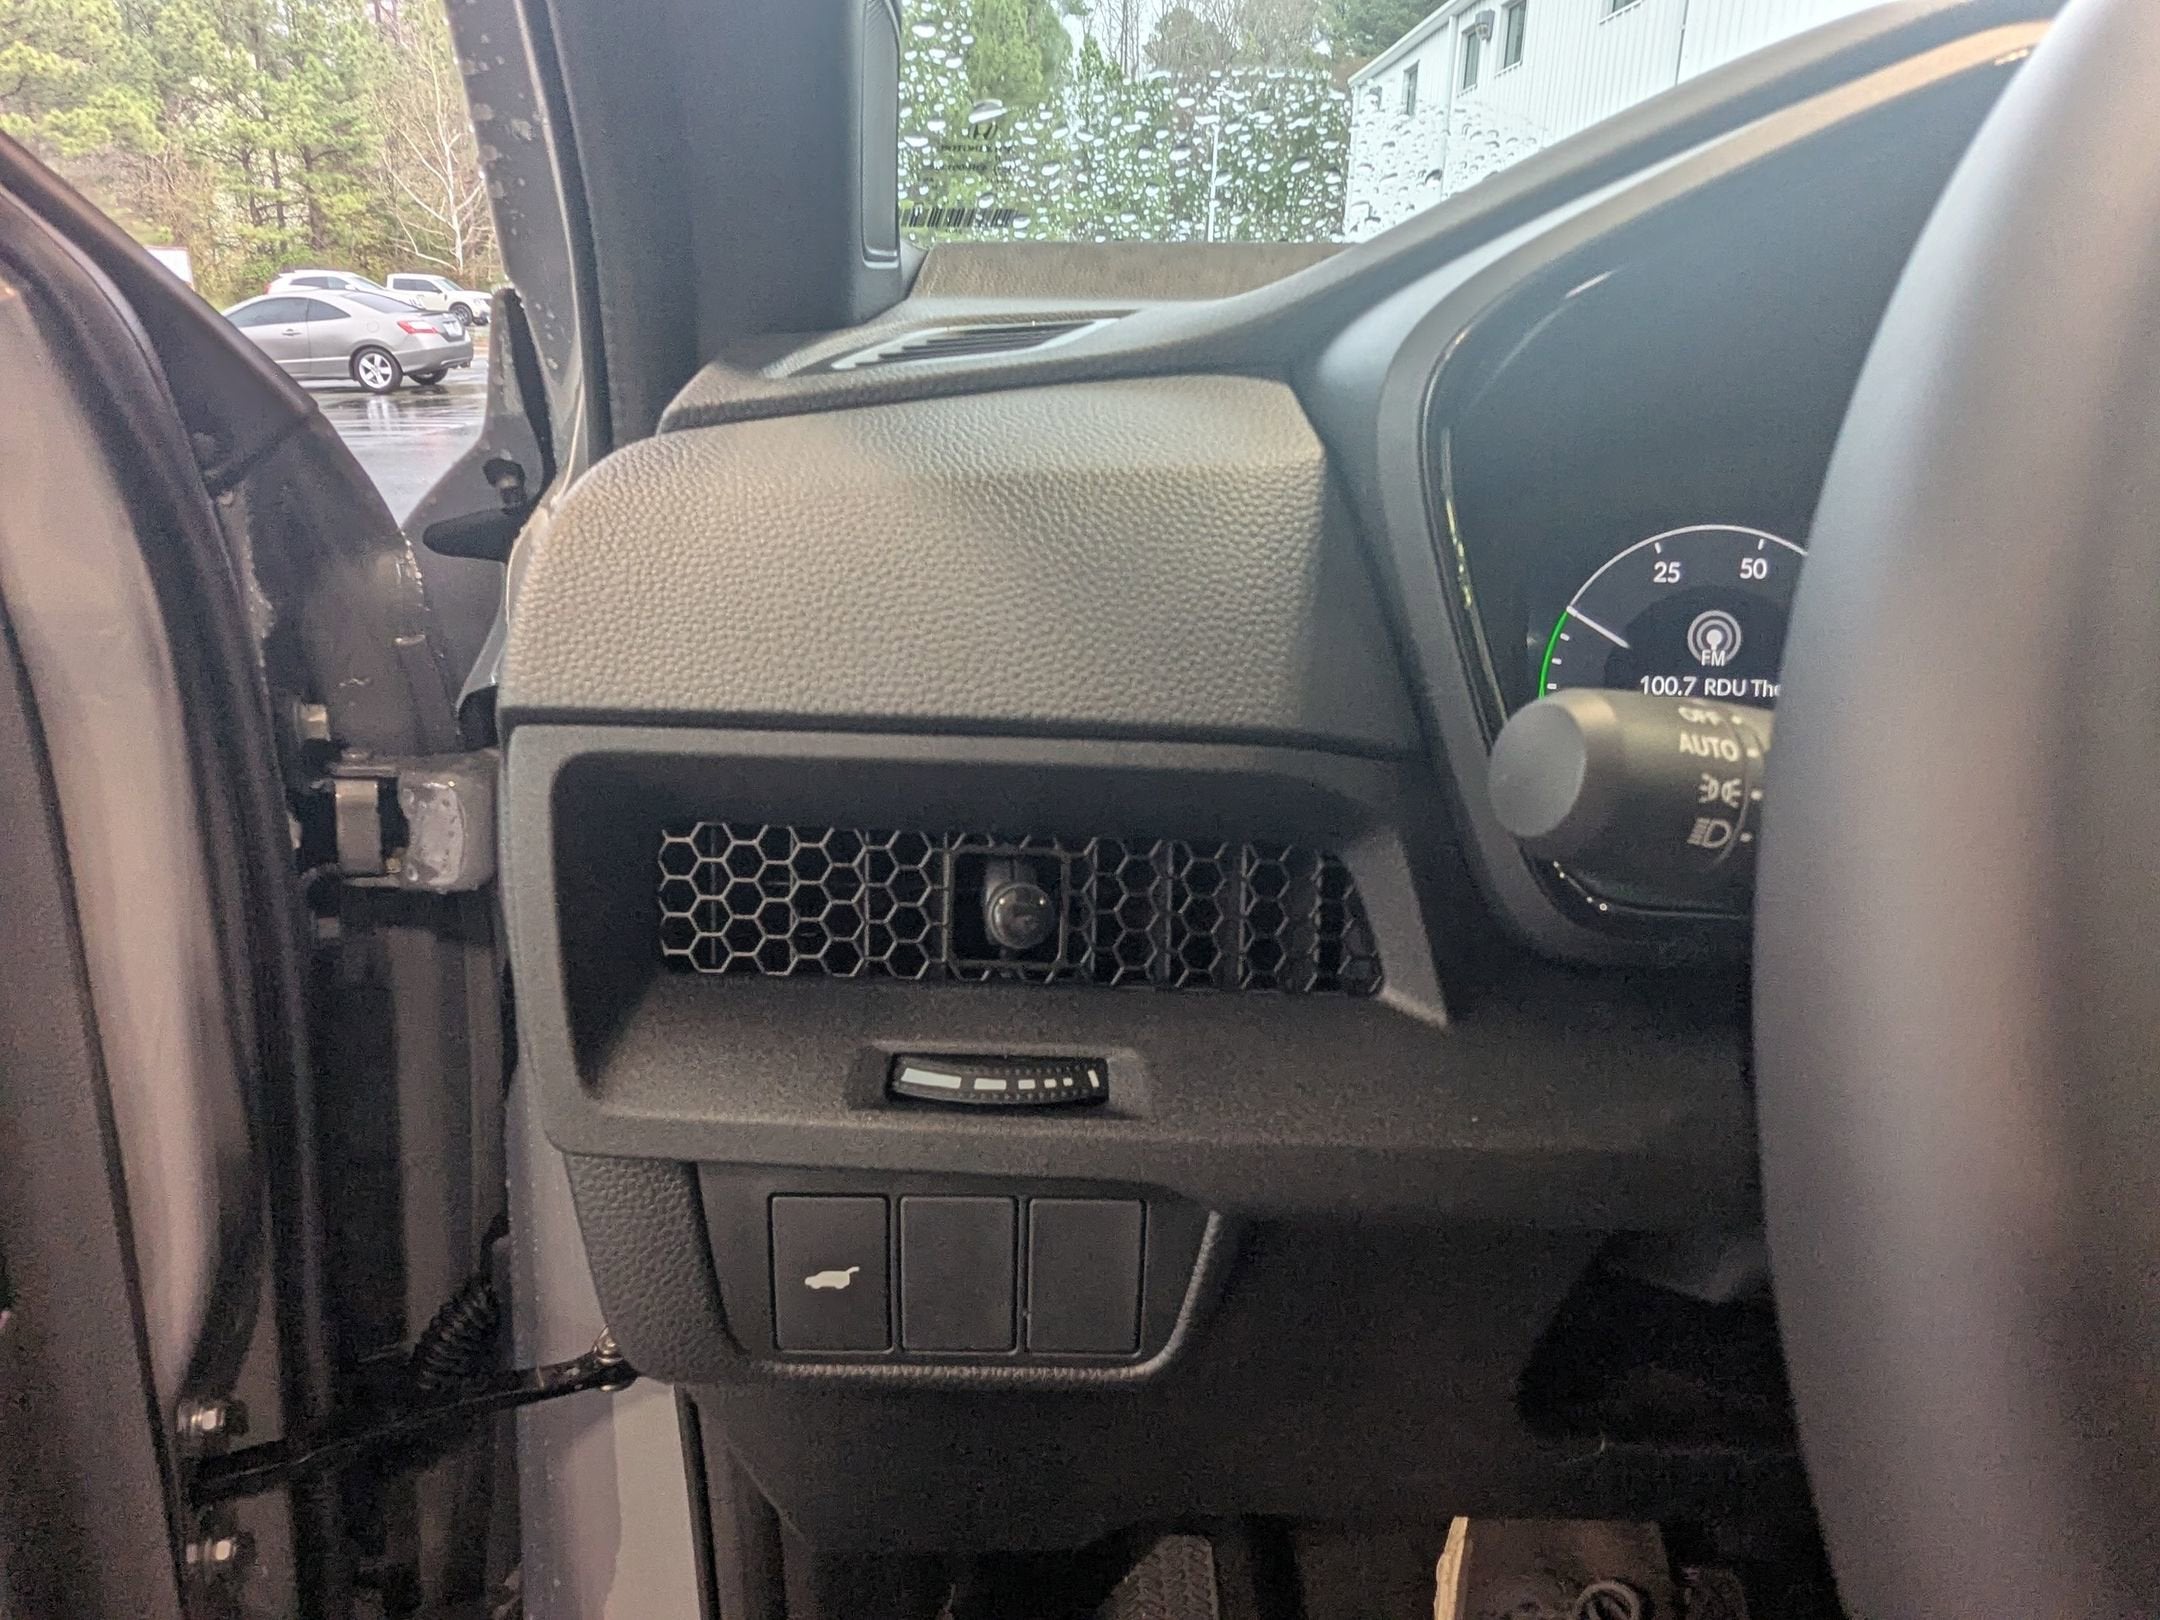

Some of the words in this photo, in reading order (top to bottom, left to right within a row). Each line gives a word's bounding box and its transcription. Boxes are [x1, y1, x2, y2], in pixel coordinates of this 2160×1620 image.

[1653, 562, 1681, 583] 25
[1739, 558, 1767, 580] 50
[1701, 651, 1725, 666] FM
[1640, 676, 1697, 696] 100.7
[1704, 678, 1746, 697] RDU
[1679, 731, 1740, 762] AUTO
